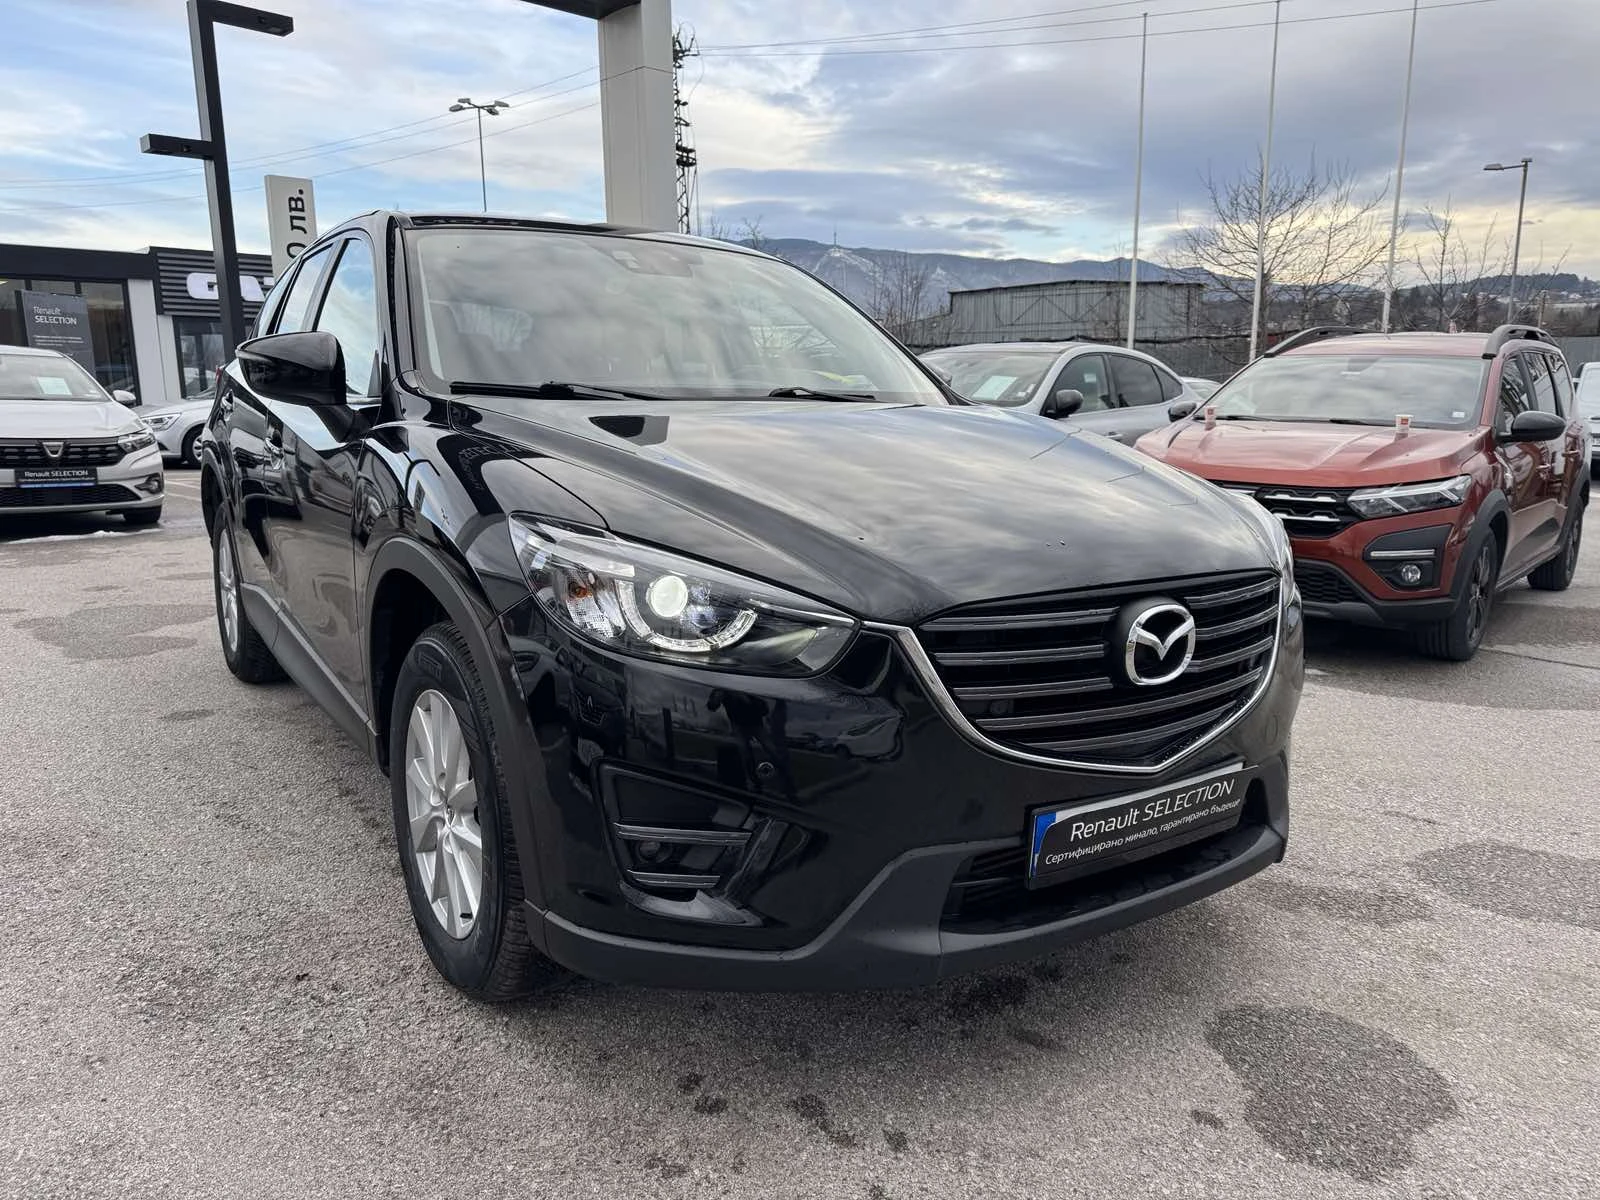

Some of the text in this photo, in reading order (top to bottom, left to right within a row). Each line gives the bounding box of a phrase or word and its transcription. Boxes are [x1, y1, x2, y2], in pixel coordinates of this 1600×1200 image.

[33, 306, 61, 315] Renault
[35, 315, 77, 325] SELECTION
[1070, 778, 1235, 842] Renault SELECTION
[1045, 838, 1124, 865] Сертифицирано
[1125, 827, 1159, 844] минало,
[1160, 808, 1209, 832] гарантирано
